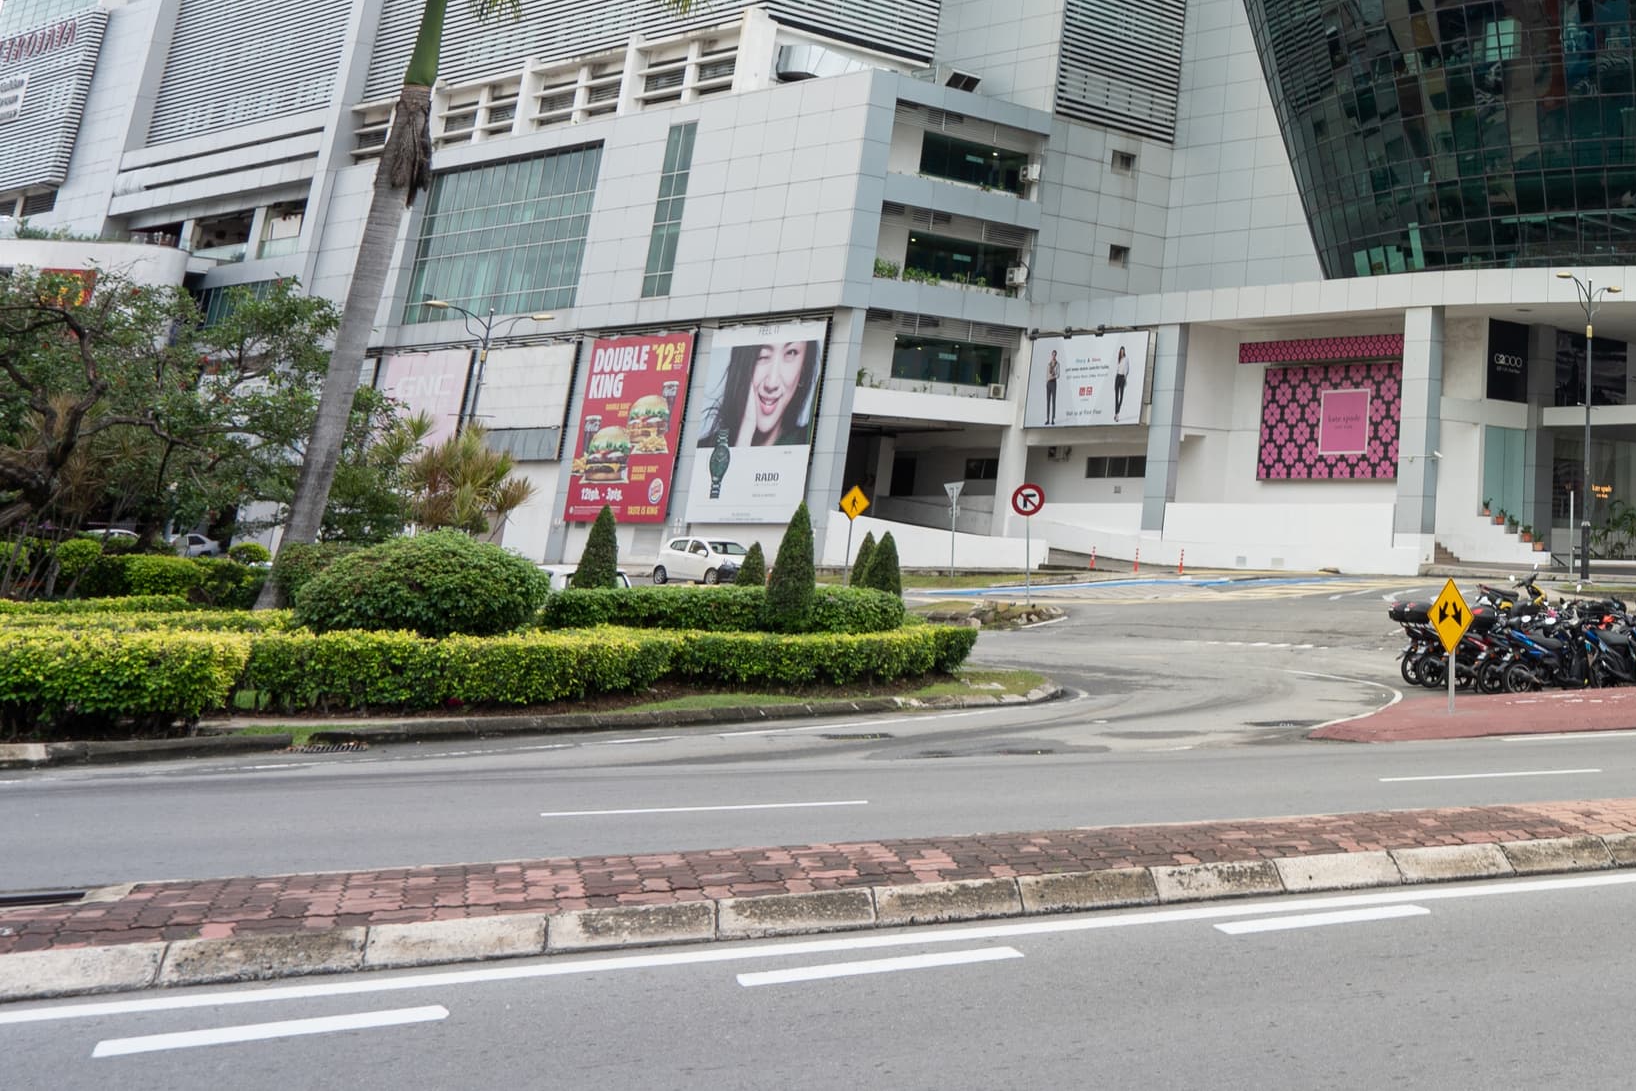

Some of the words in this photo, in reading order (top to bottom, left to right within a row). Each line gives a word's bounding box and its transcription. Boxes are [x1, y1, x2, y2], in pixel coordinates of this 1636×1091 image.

[593, 345, 650, 373] DOUBLE
[1494, 353, 1523, 368] G2000
[397, 374, 456, 398] GNC
[589, 373, 625, 399] KING
[755, 472, 780, 483] RADO
